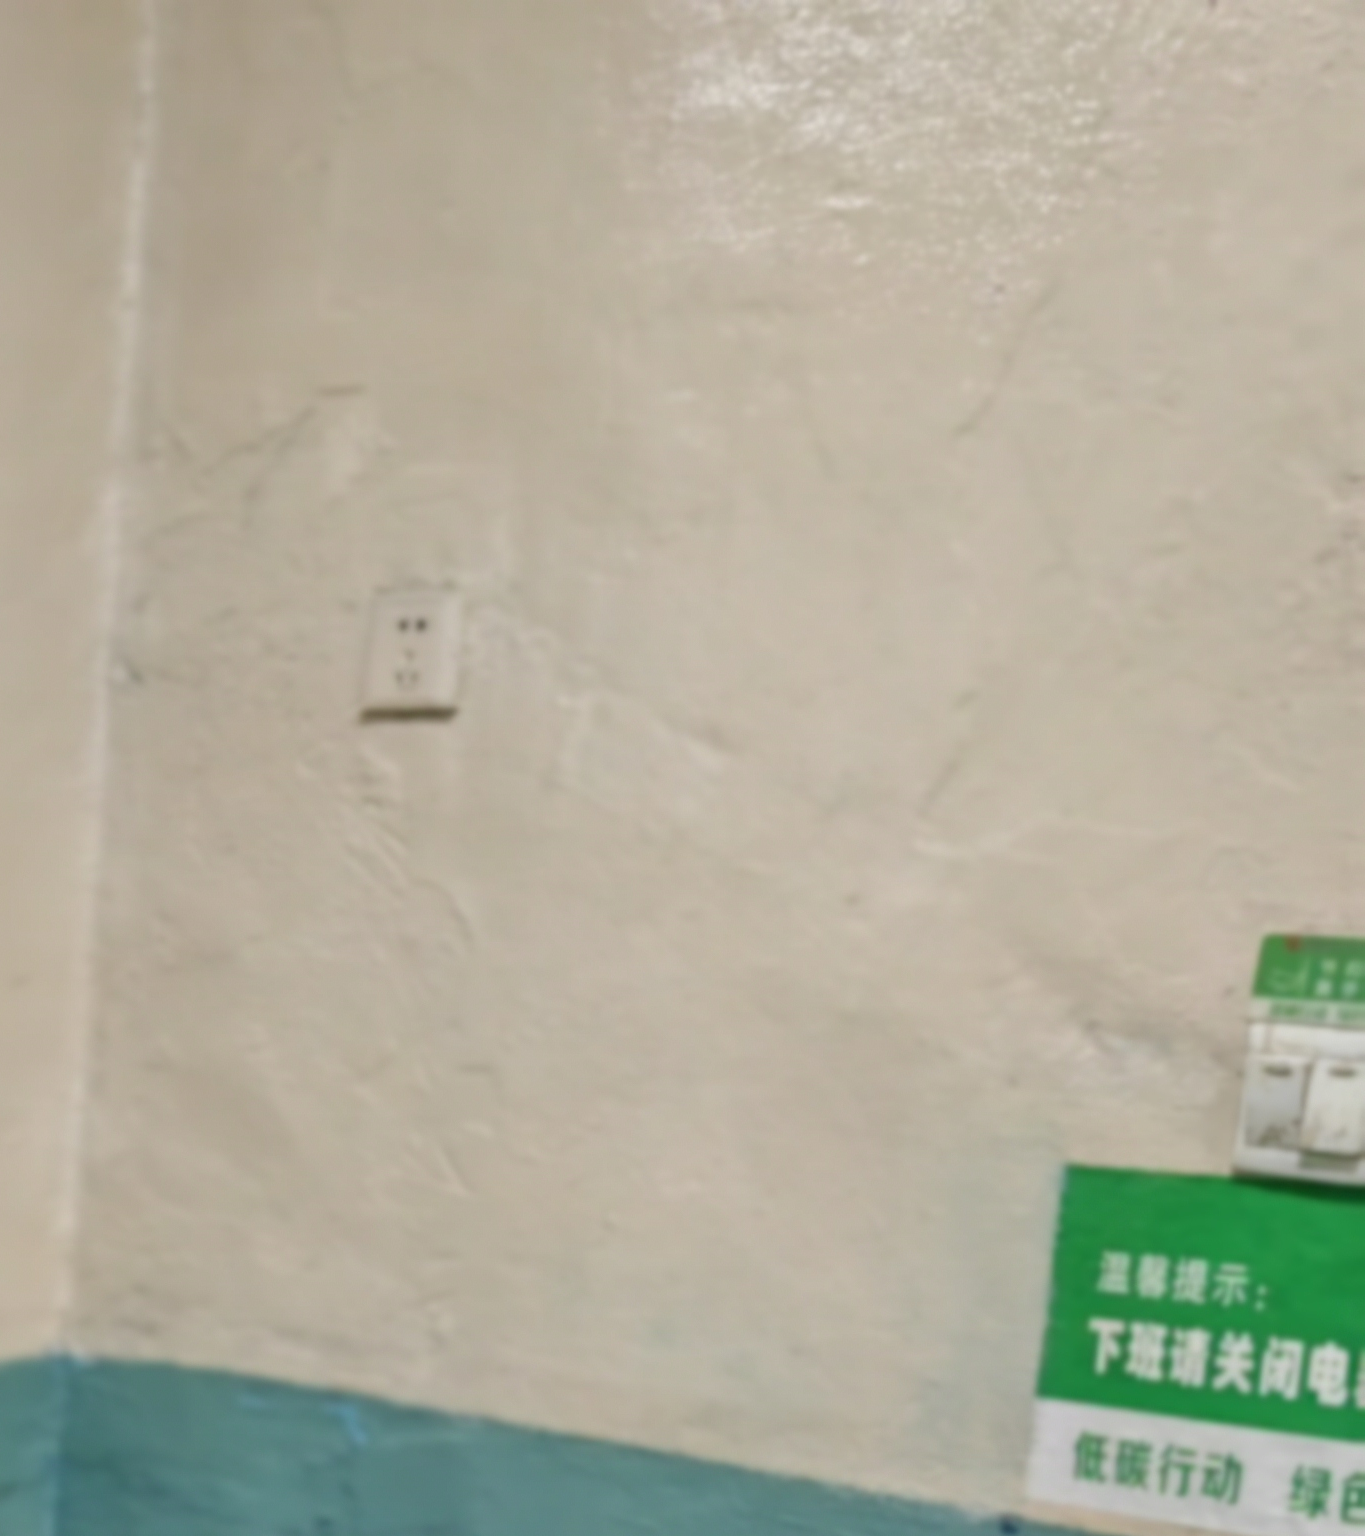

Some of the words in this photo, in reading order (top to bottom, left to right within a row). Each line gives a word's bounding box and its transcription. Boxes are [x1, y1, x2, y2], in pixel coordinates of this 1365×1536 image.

[1088, 1317, 1365, 1410] 下班请关闭电
[1073, 1431, 1244, 1506] 低碳行动
